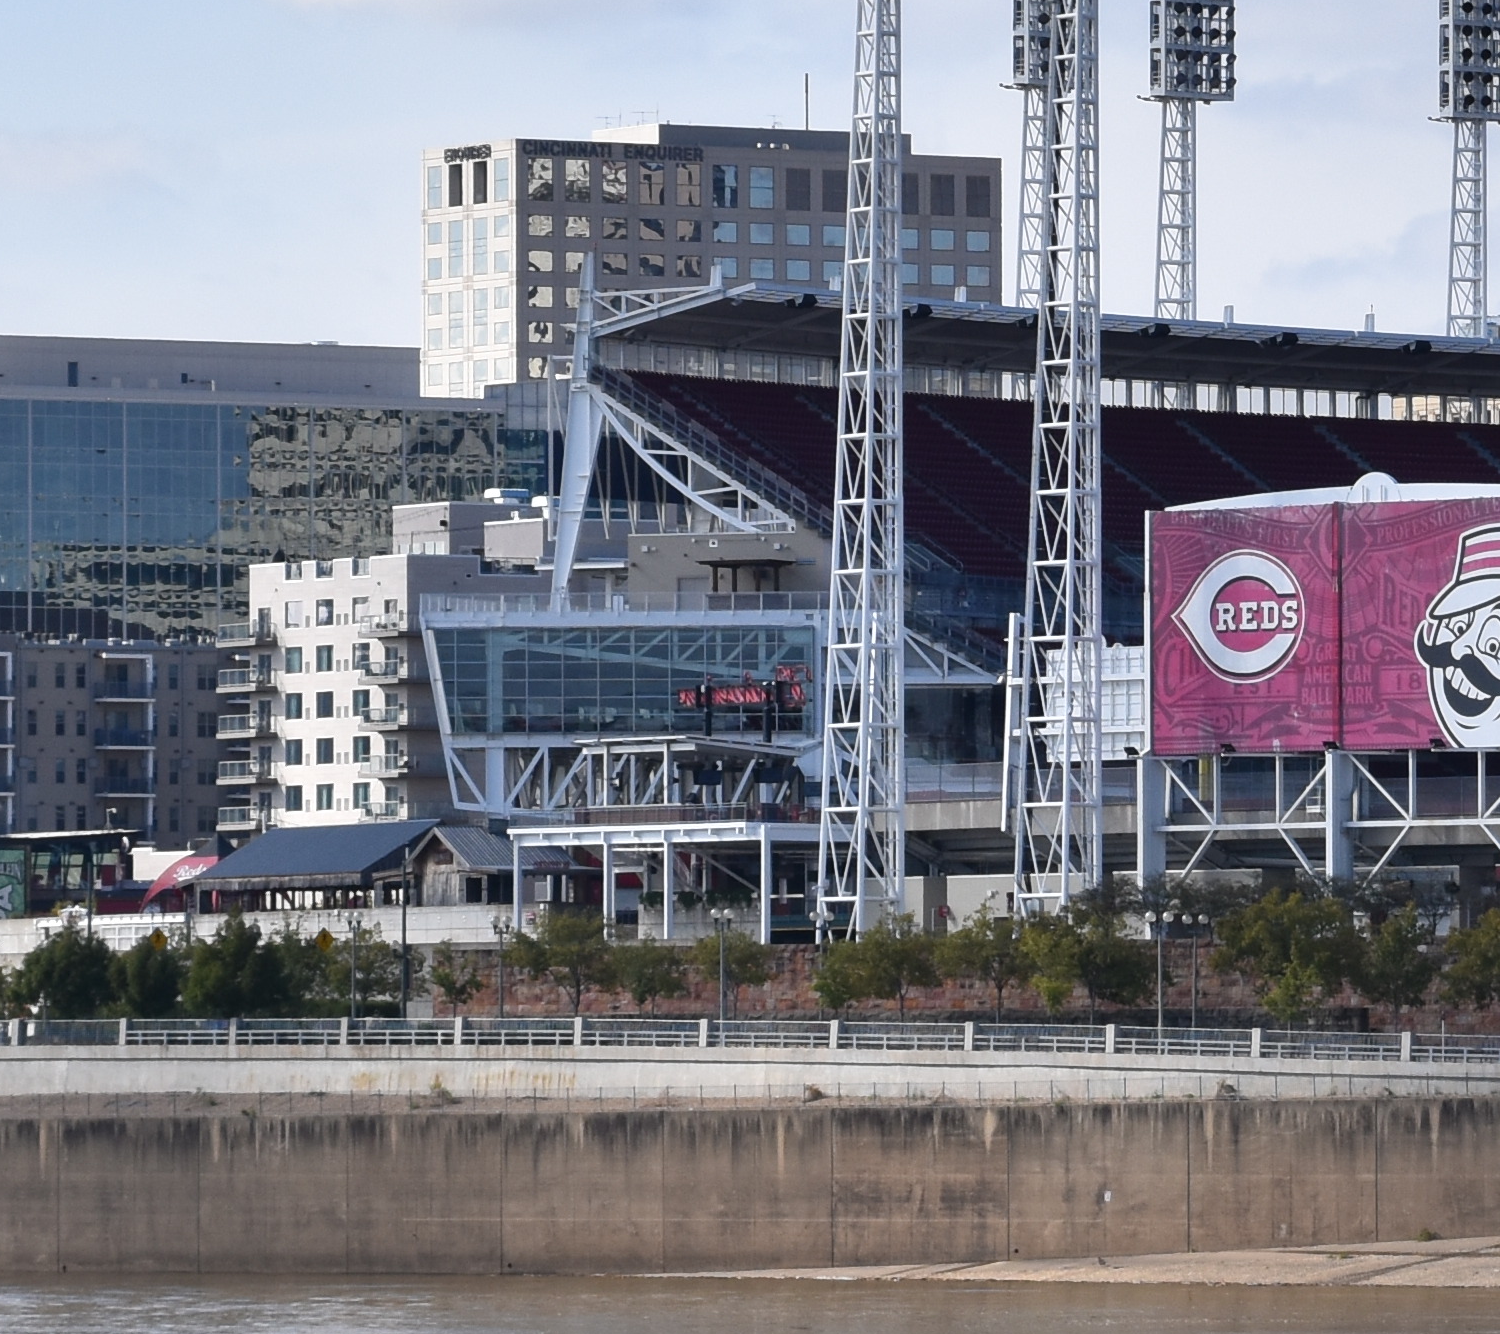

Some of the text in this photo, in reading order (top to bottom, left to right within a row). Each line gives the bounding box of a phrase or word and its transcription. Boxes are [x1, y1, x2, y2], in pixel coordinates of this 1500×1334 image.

[522, 140, 704, 162] CINCINNATI ENQUIRER
[1259, 525, 1300, 548] FIRST
[1376, 499, 1480, 543] PROFESSIONAL
[1216, 600, 1298, 632] REDS
